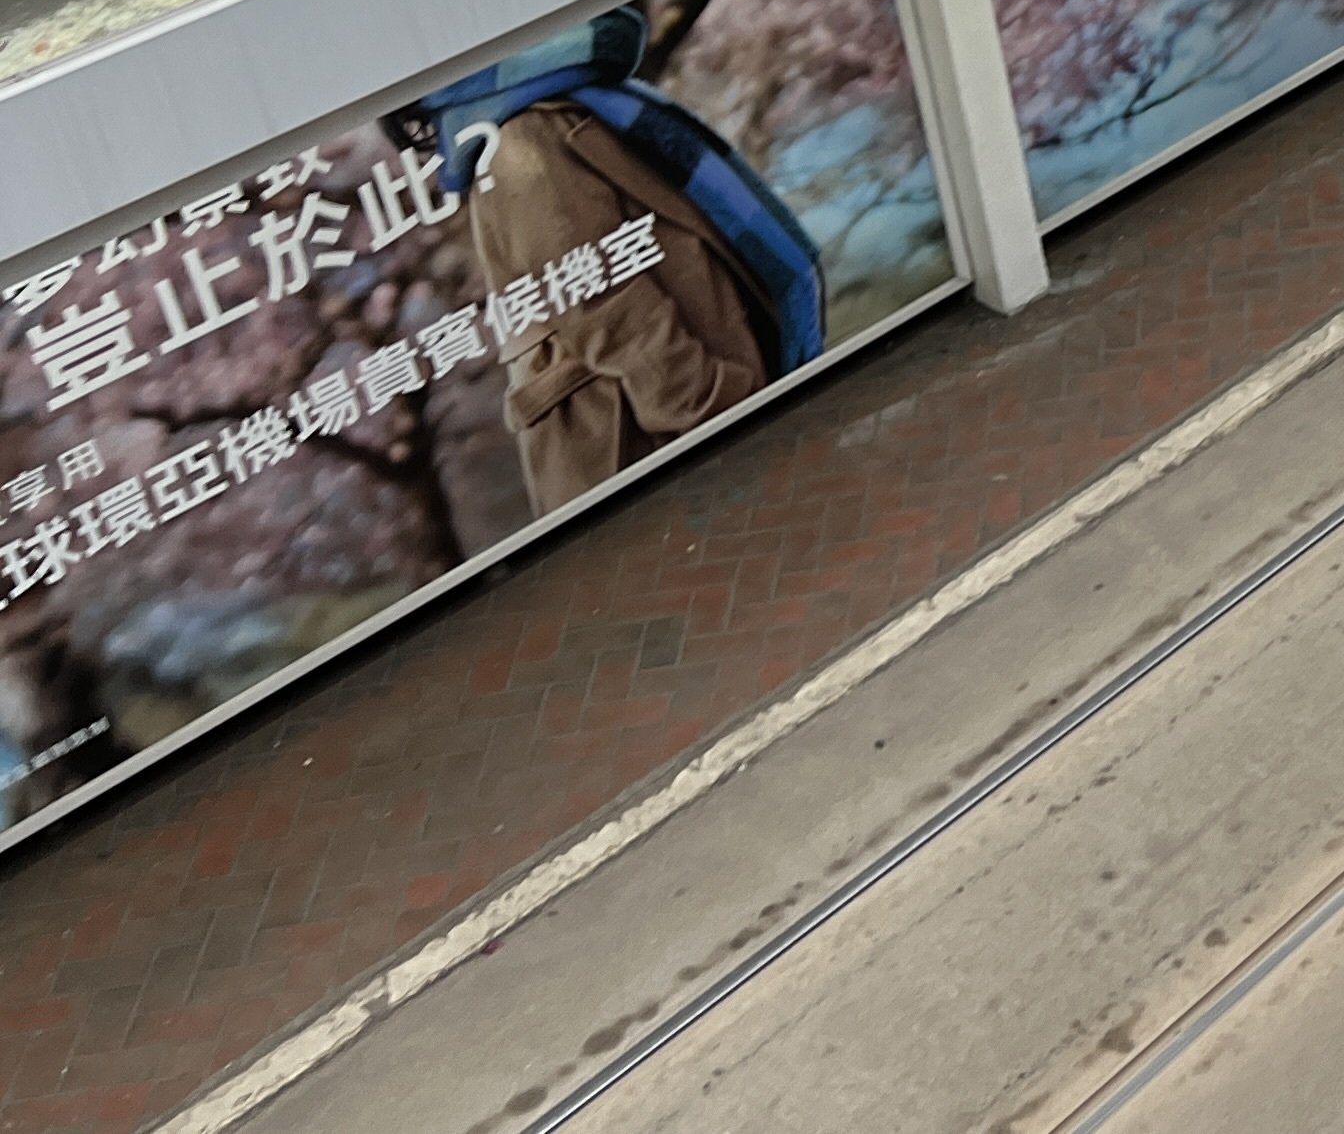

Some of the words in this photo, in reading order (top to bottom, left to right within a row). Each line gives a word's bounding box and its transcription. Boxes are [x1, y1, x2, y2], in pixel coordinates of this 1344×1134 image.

[0, 211, 665, 610] 球環亞機場貴賓候機室
[26, 120, 501, 411] 豈止於此?
[0, 439, 106, 527] 享用
